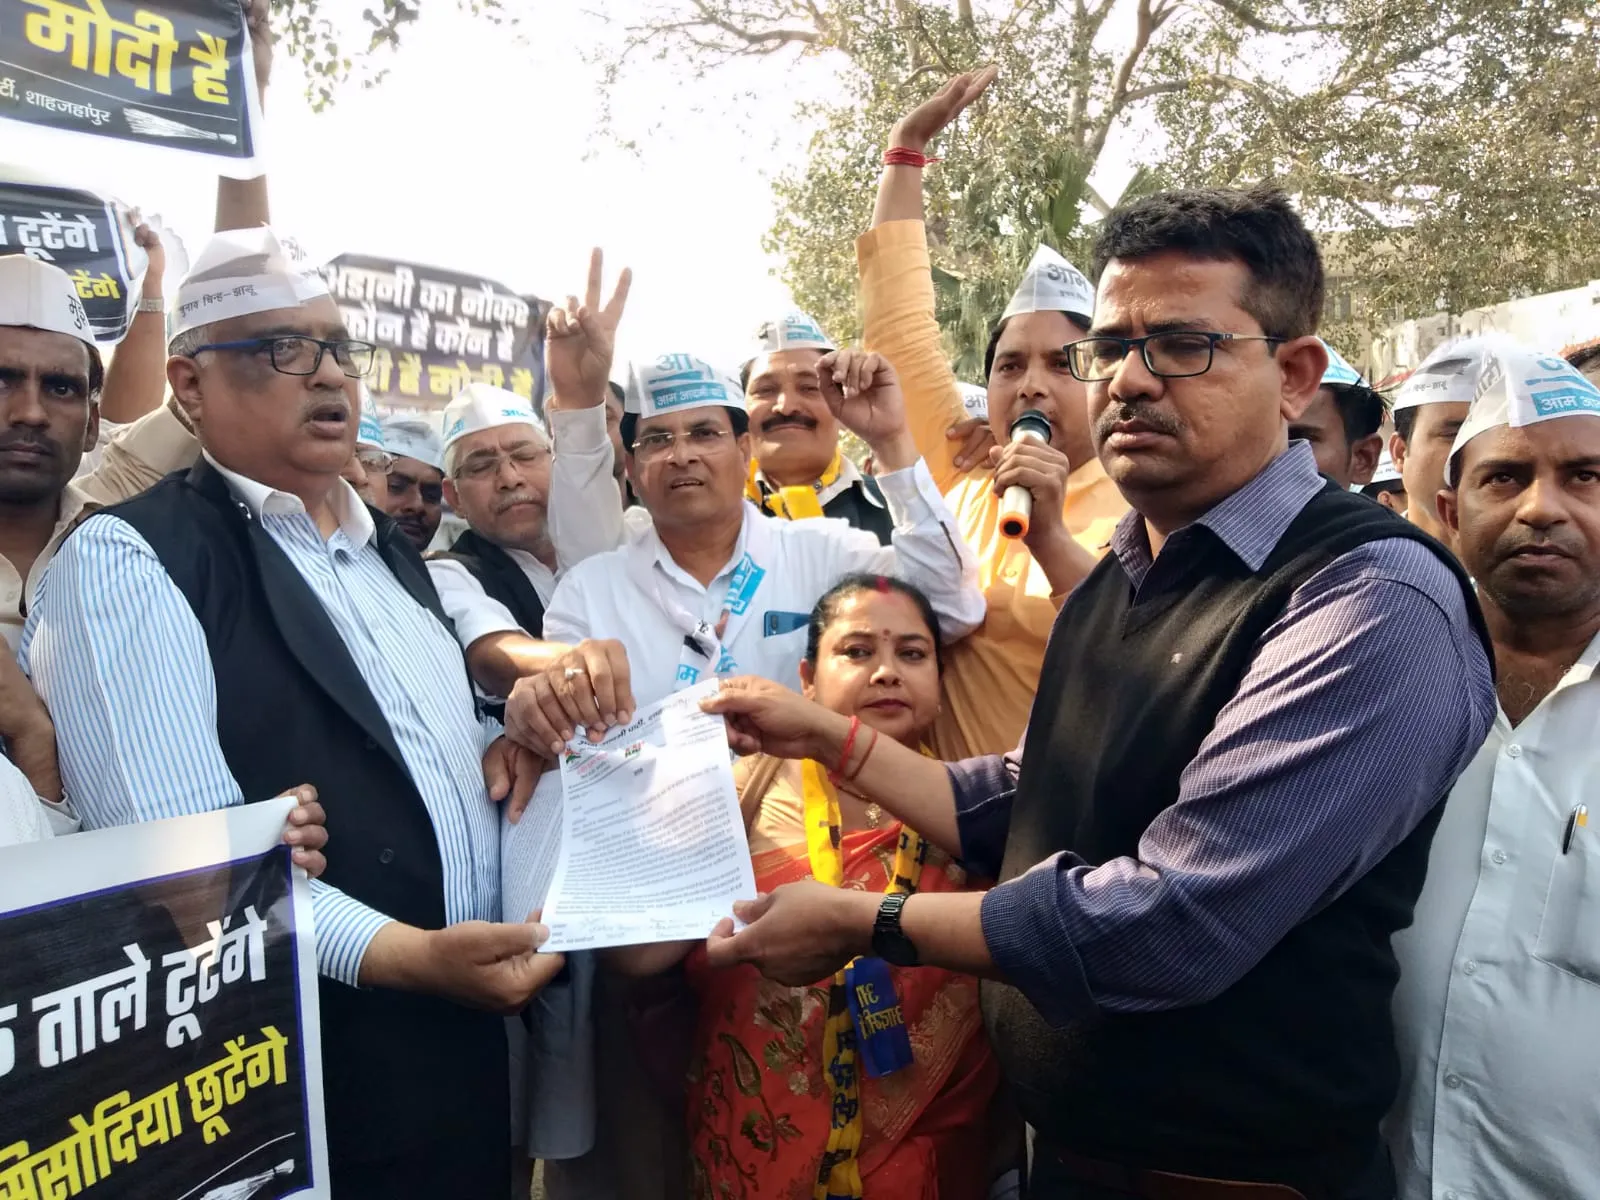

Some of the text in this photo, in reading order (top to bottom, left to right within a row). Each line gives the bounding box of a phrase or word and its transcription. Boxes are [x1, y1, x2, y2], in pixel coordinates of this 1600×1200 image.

[20, 0, 230, 105] मोदी है
[26, 90, 112, 125] शाहजहांपुर
[11, 211, 100, 261] टूटेंगे
[66, 268, 121, 299] टेंगे
[419, 278, 457, 318] का
[1540, 396, 1579, 411] आम
[31, 942, 152, 1068] ताले
[161, 905, 269, 1049] टूटेंगे
[184, 1025, 289, 1145] छूटेंगे
